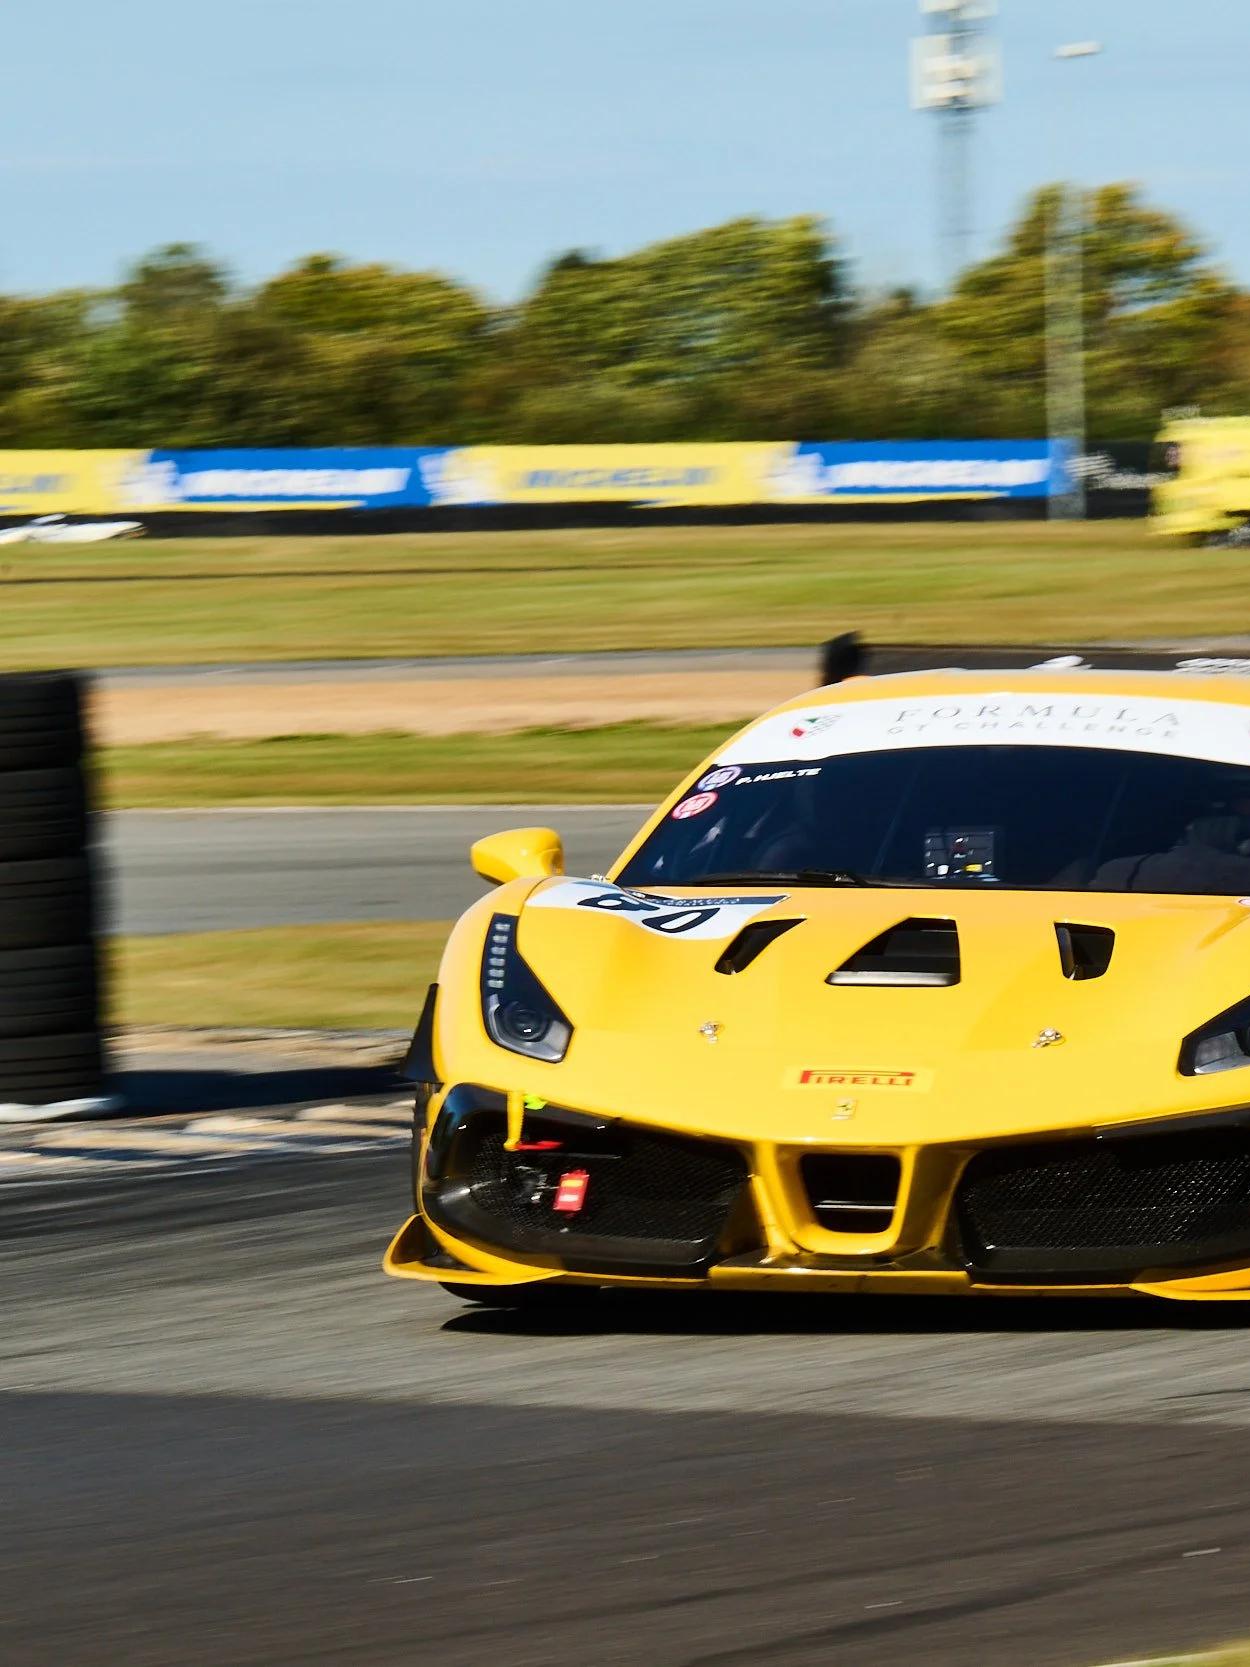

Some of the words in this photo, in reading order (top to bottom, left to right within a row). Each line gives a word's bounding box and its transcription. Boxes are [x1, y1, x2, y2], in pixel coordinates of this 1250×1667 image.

[895, 704, 1180, 726] FORMULA
[887, 723, 929, 735] GT
[953, 721, 1181, 738] CHALLENGE
[800, 1069, 916, 1086] PIRELLI
